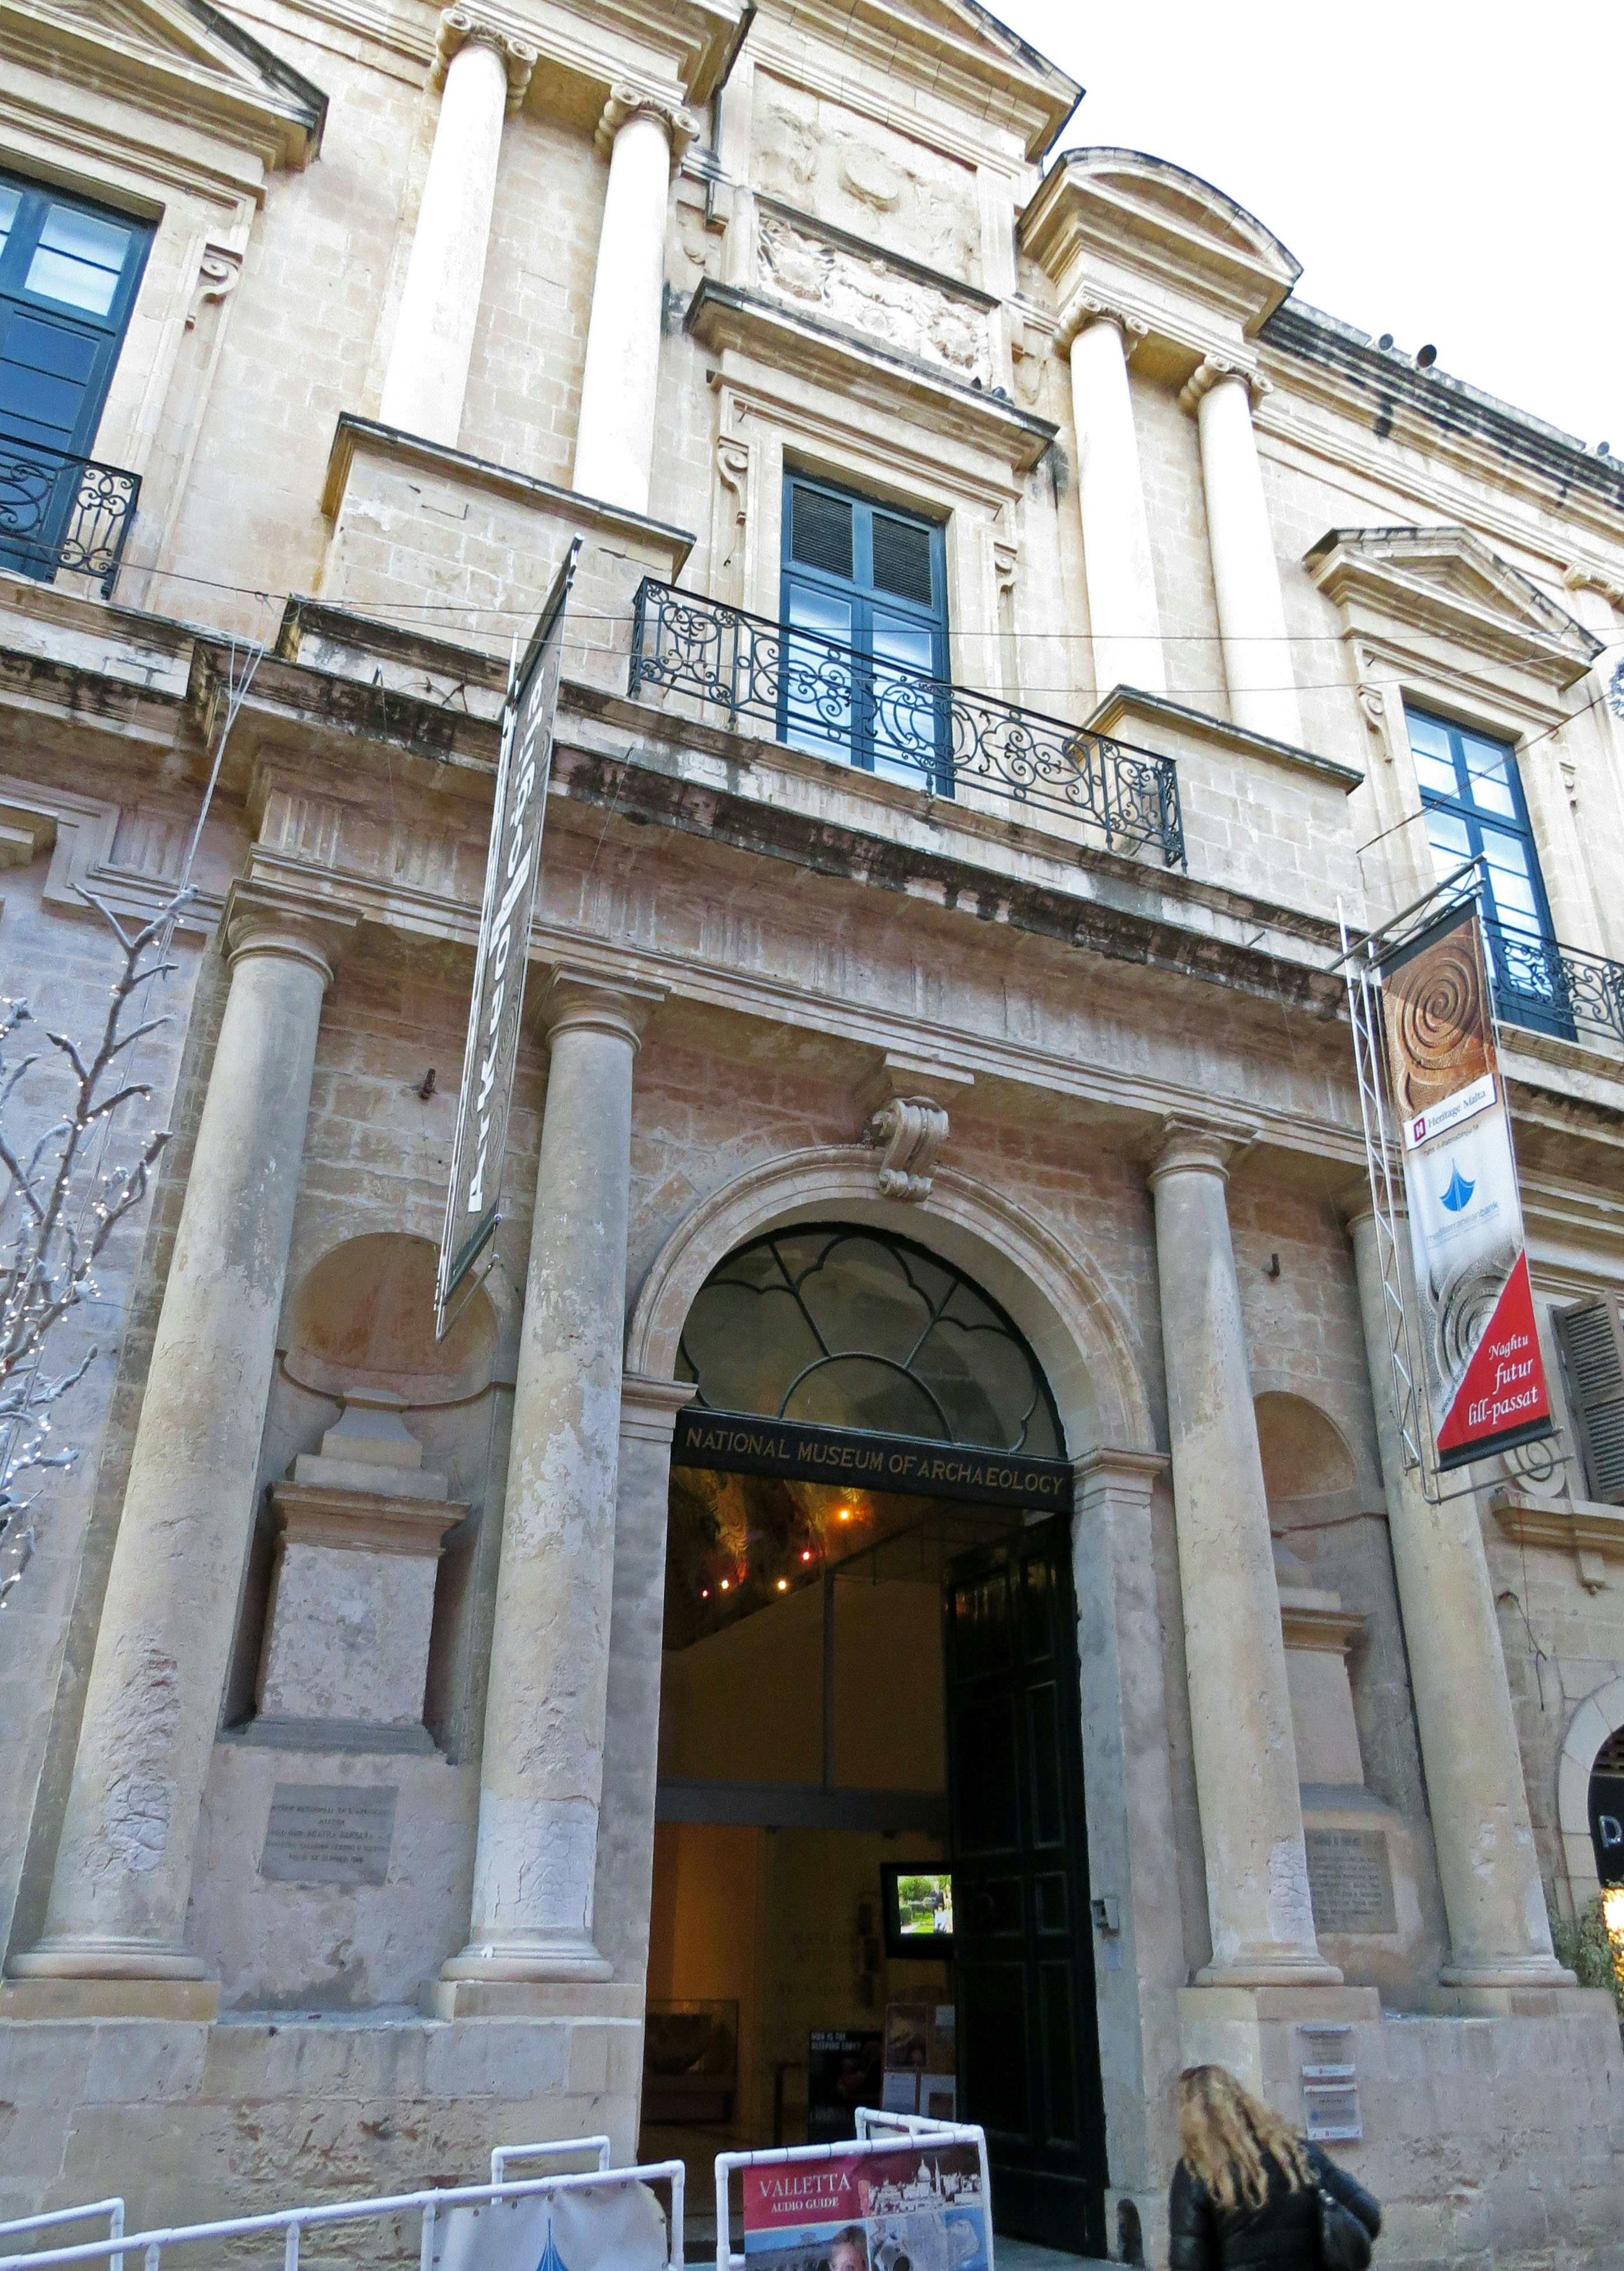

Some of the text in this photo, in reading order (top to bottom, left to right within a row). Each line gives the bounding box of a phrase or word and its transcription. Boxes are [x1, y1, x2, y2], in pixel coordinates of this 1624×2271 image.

[1428, 1105, 1461, 1128] Heritage
[1463, 1090, 1486, 1108] Malta
[1492, 1359, 1533, 1394] futur
[1469, 1387, 1538, 1426] lill-passat
[685, 1428, 1064, 1495] NATIONAL MUSEUM OF ARCHAEOLOGY
[759, 2171, 851, 2197] VALLETTA
[772, 2197, 839, 2213] AUDIO GUIDE
